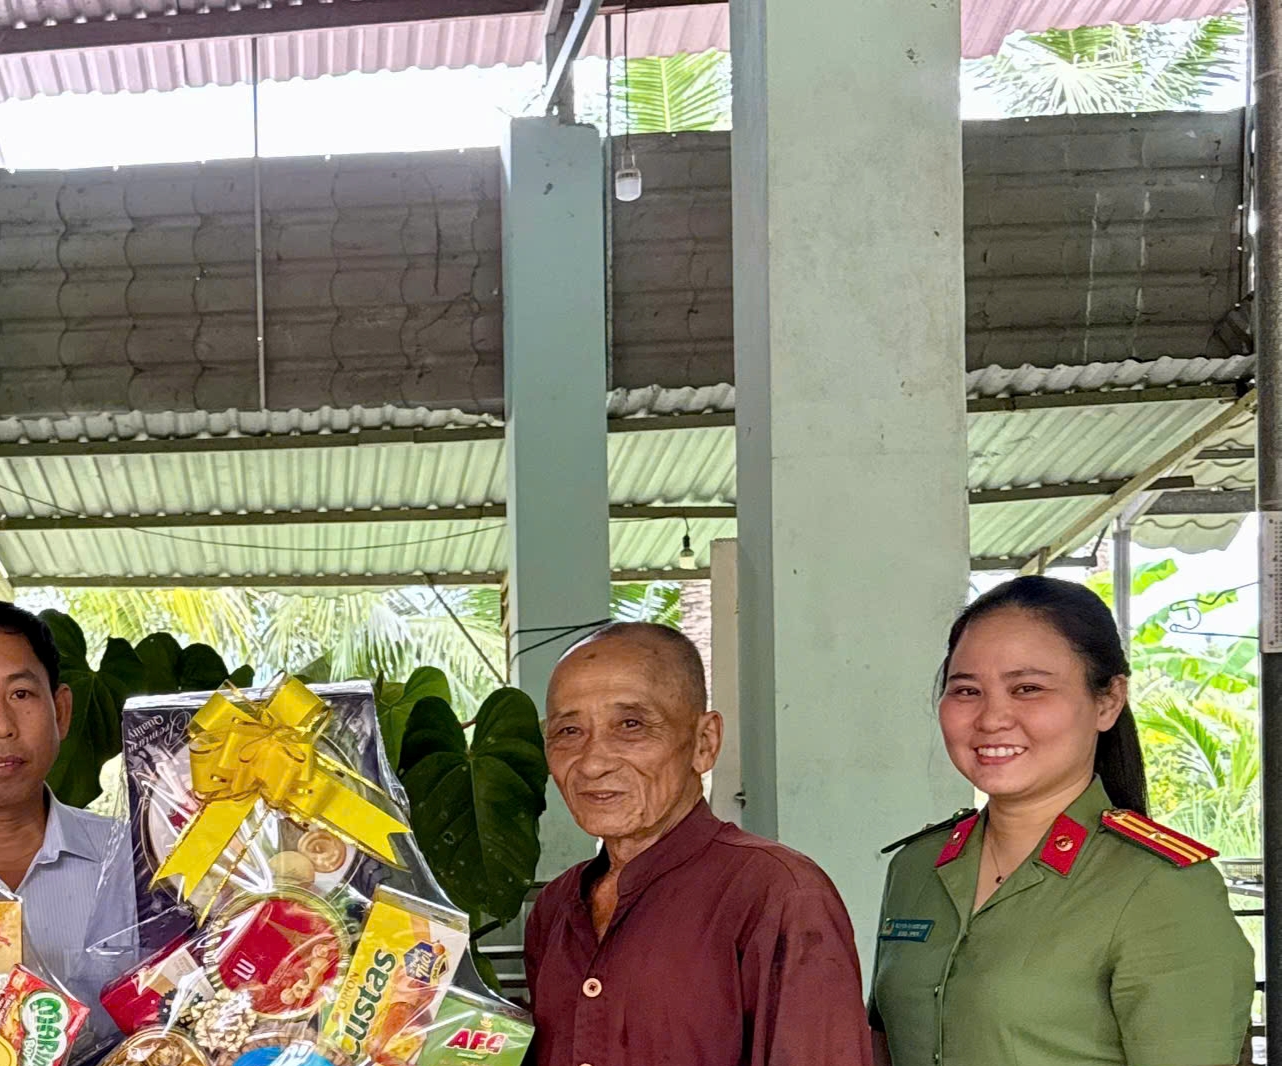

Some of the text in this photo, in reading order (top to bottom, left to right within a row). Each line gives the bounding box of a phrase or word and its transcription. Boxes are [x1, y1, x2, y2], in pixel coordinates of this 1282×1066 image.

[127, 714, 164, 738] Quality
[232, 958, 256, 981] LU
[338, 971, 360, 1010] ORION
